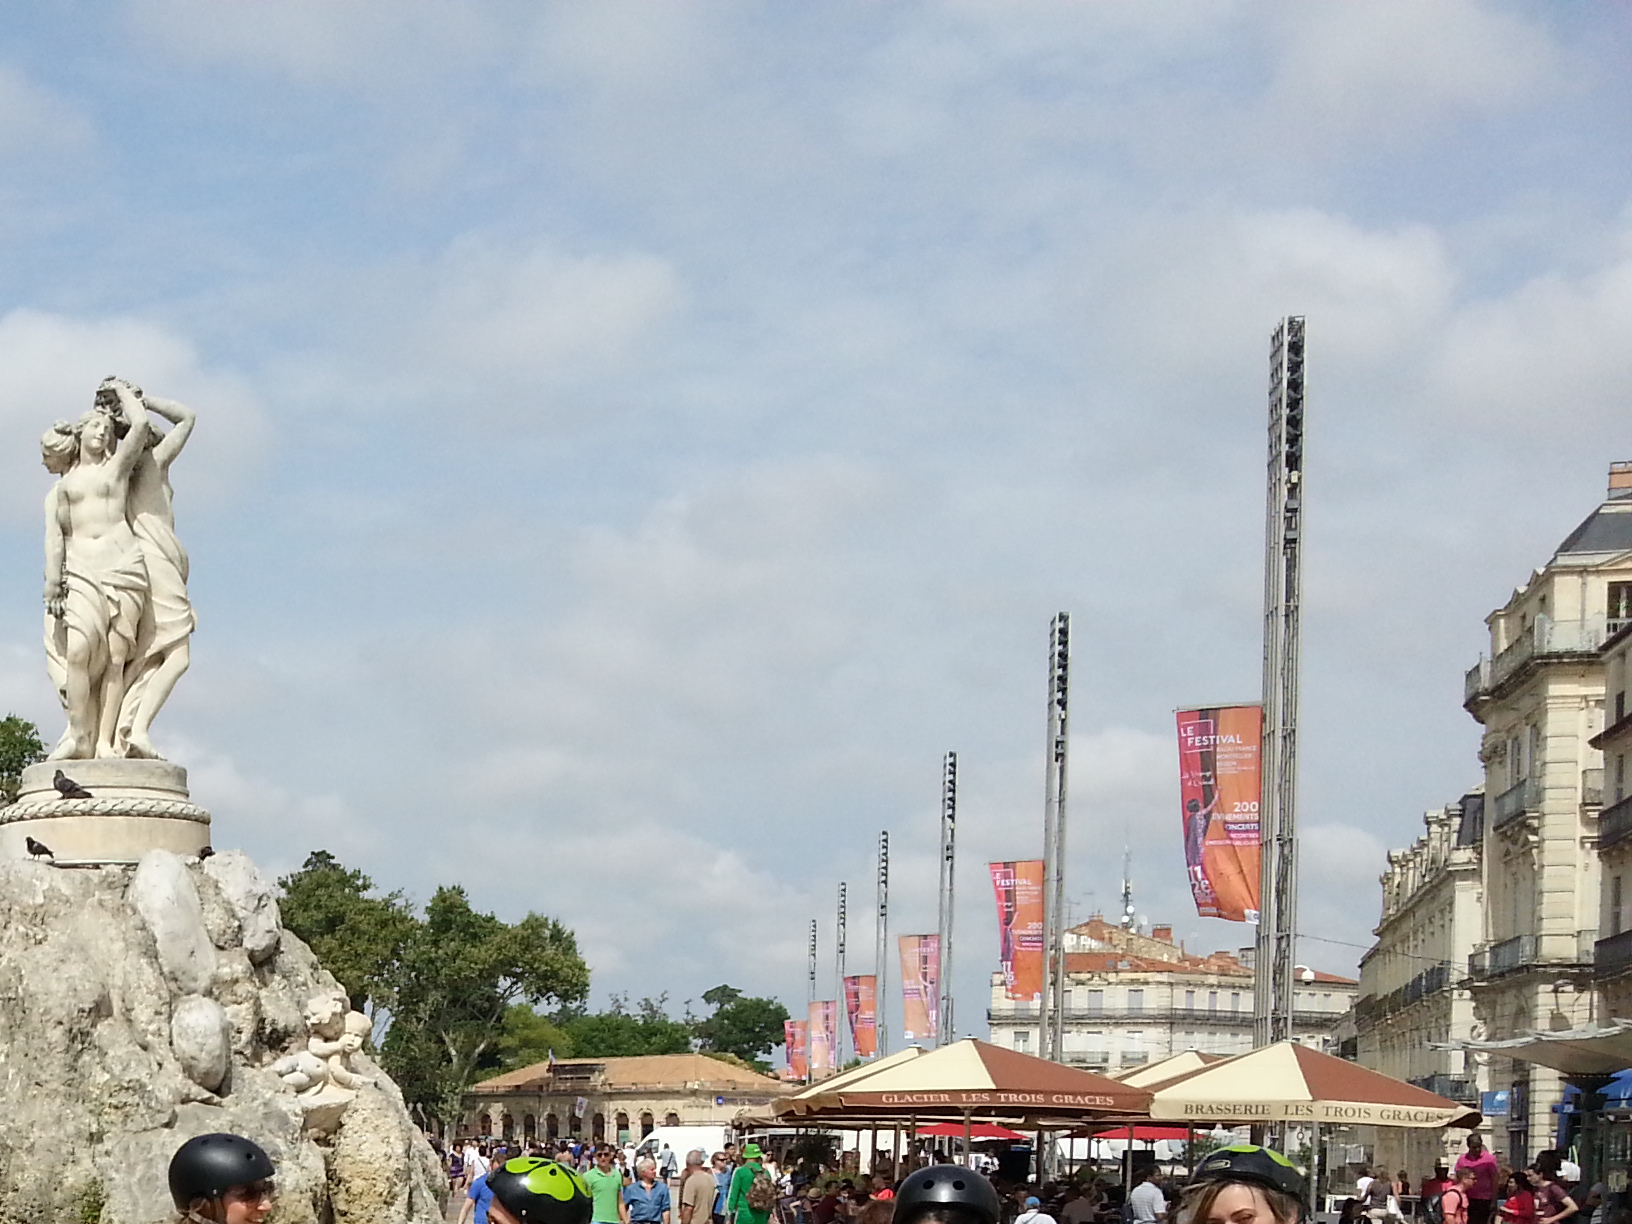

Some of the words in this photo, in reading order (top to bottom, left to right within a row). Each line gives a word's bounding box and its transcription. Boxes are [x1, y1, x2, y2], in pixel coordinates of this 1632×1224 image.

[1181, 726, 1194, 737] LE
[1188, 734, 1242, 746] FESTIVAL
[1234, 802, 1259, 812] 200
[882, 1093, 950, 1103] GLACIER
[962, 1092, 990, 1102] LES
[997, 1092, 1044, 1104] TROIS
[1052, 1094, 1114, 1106] GRACES
[1184, 1104, 1270, 1115] BRASSERIE
[1284, 1104, 1313, 1116] LES
[1322, 1106, 1370, 1118] TROIS
[1380, 1109, 1444, 1123] GRACES
